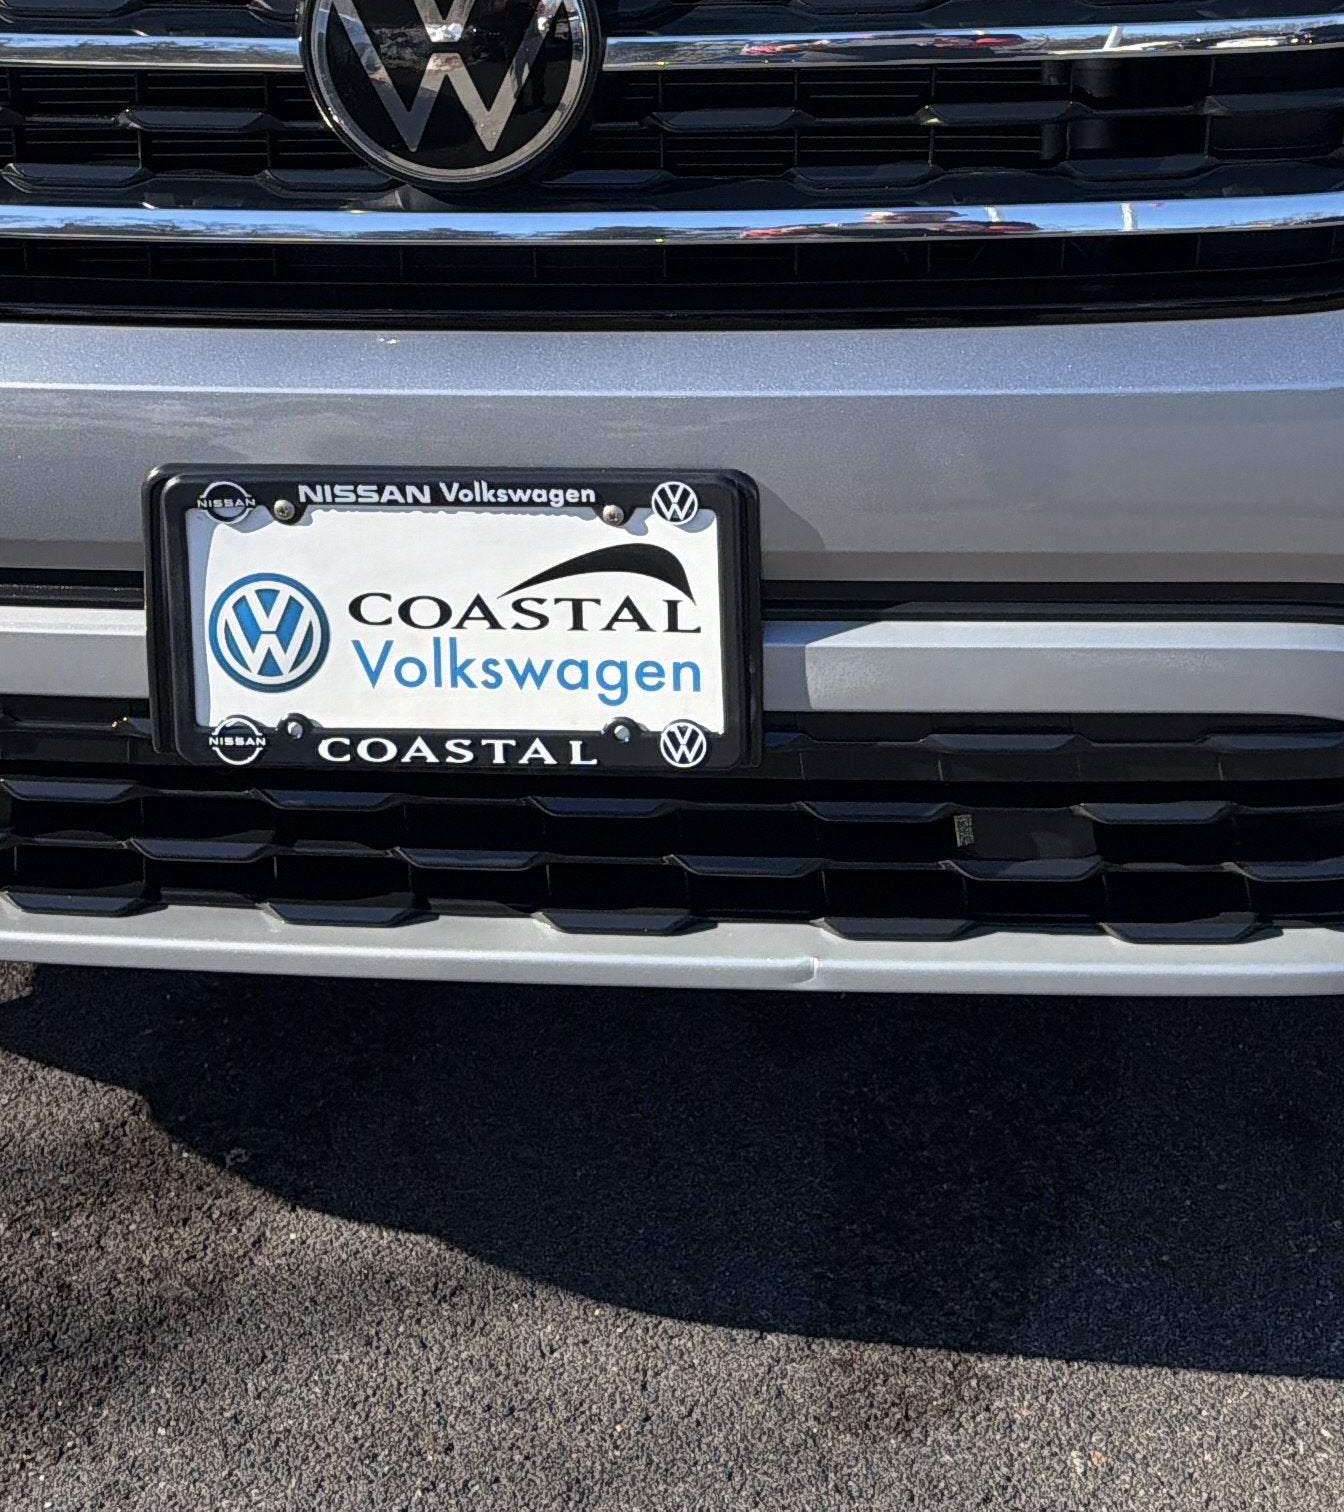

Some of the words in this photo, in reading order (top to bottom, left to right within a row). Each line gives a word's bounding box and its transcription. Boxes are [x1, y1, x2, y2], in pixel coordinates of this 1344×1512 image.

[197, 497, 256, 509] NISSAN
[298, 484, 431, 504] NISSAN
[438, 481, 596, 507] Volkswagen
[348, 591, 702, 634] COASTAL
[350, 636, 702, 707] Volkswagen
[208, 736, 267, 747] NISSAN
[317, 737, 598, 766] COASTAL
